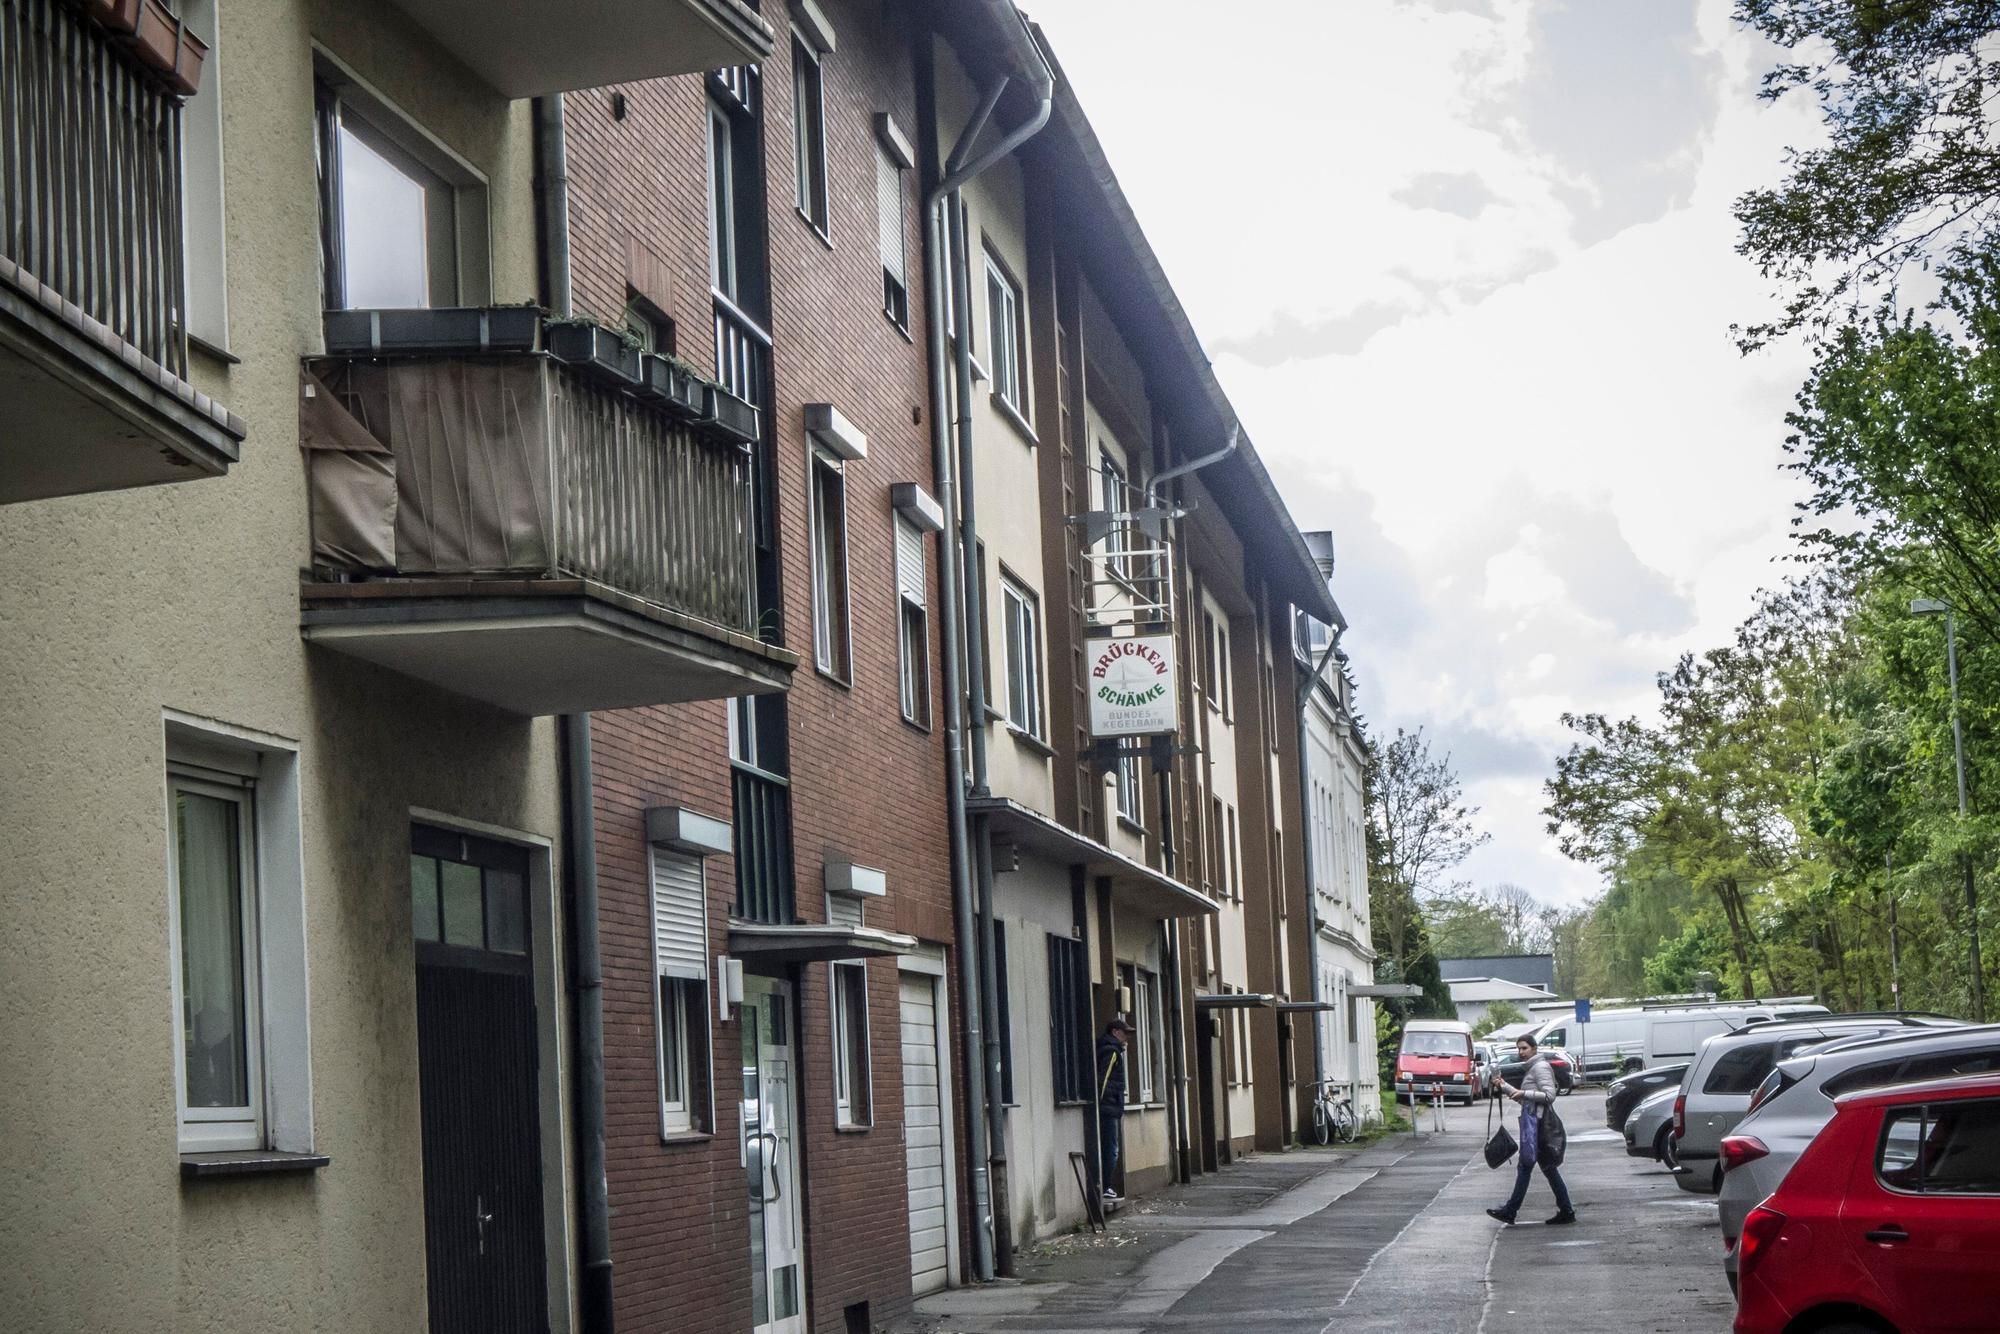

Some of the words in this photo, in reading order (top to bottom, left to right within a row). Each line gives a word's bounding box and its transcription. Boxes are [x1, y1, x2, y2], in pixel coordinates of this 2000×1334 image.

[1093, 642, 1168, 679] BRÜCKEN
[1097, 683, 1166, 707] SCHÄNKE
[1102, 718, 1164, 728] KEGELBAHN
